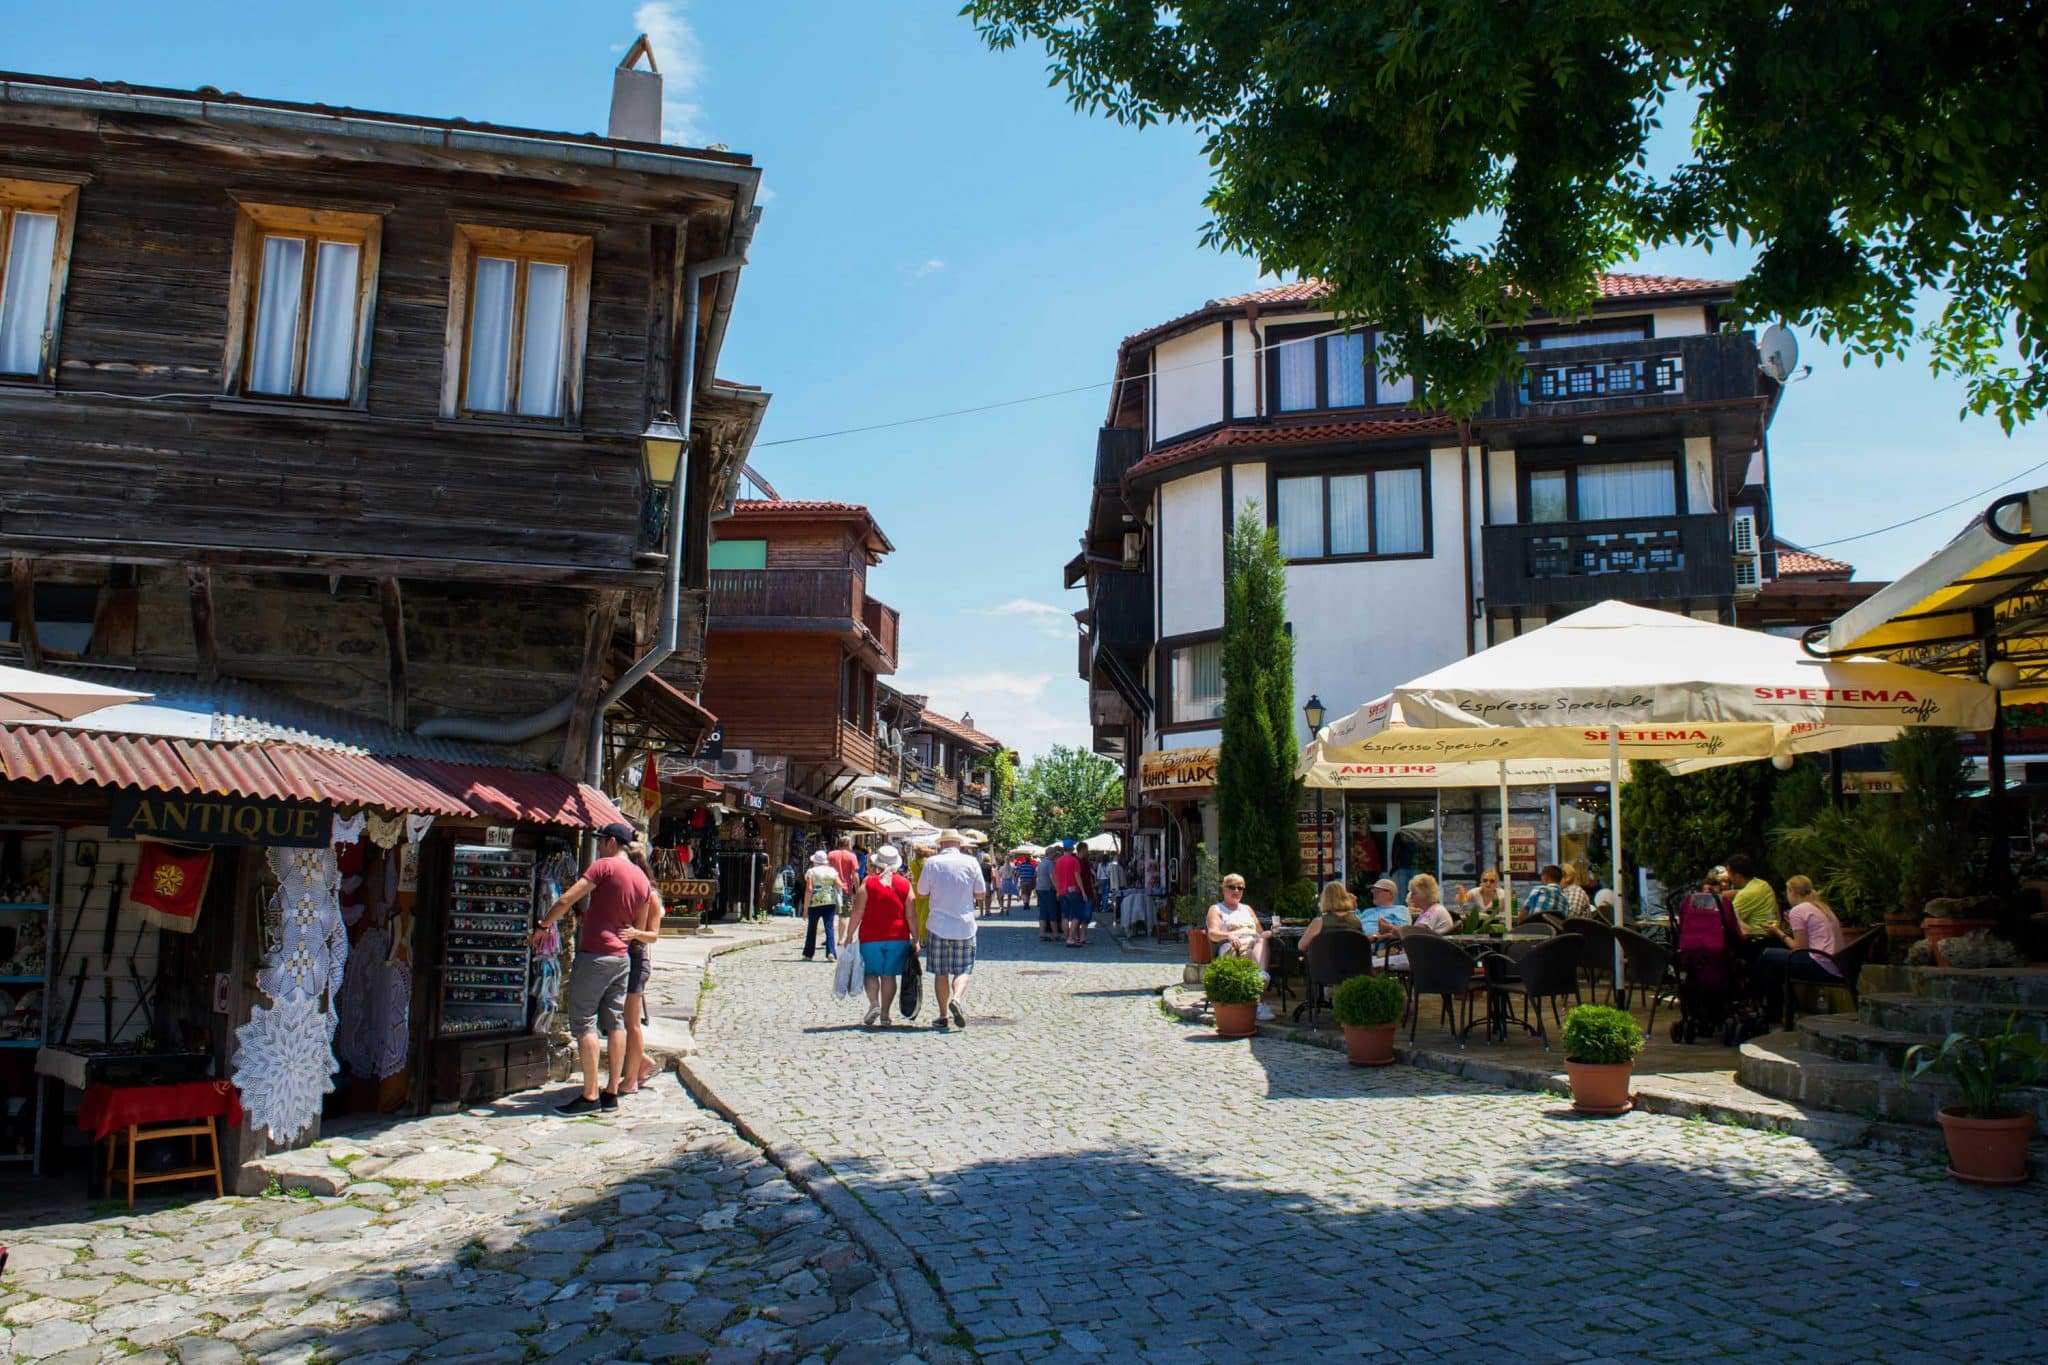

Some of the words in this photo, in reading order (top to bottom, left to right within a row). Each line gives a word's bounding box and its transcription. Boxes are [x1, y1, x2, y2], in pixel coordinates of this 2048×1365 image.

[1754, 687, 1918, 702] SPETEMA
[1458, 698, 1550, 717] Espresso
[1555, 695, 1655, 715] Speciale
[1362, 741, 1431, 755] Espresso
[1436, 737, 1509, 755] Speciale
[127, 799, 320, 840] ANTIQUE
